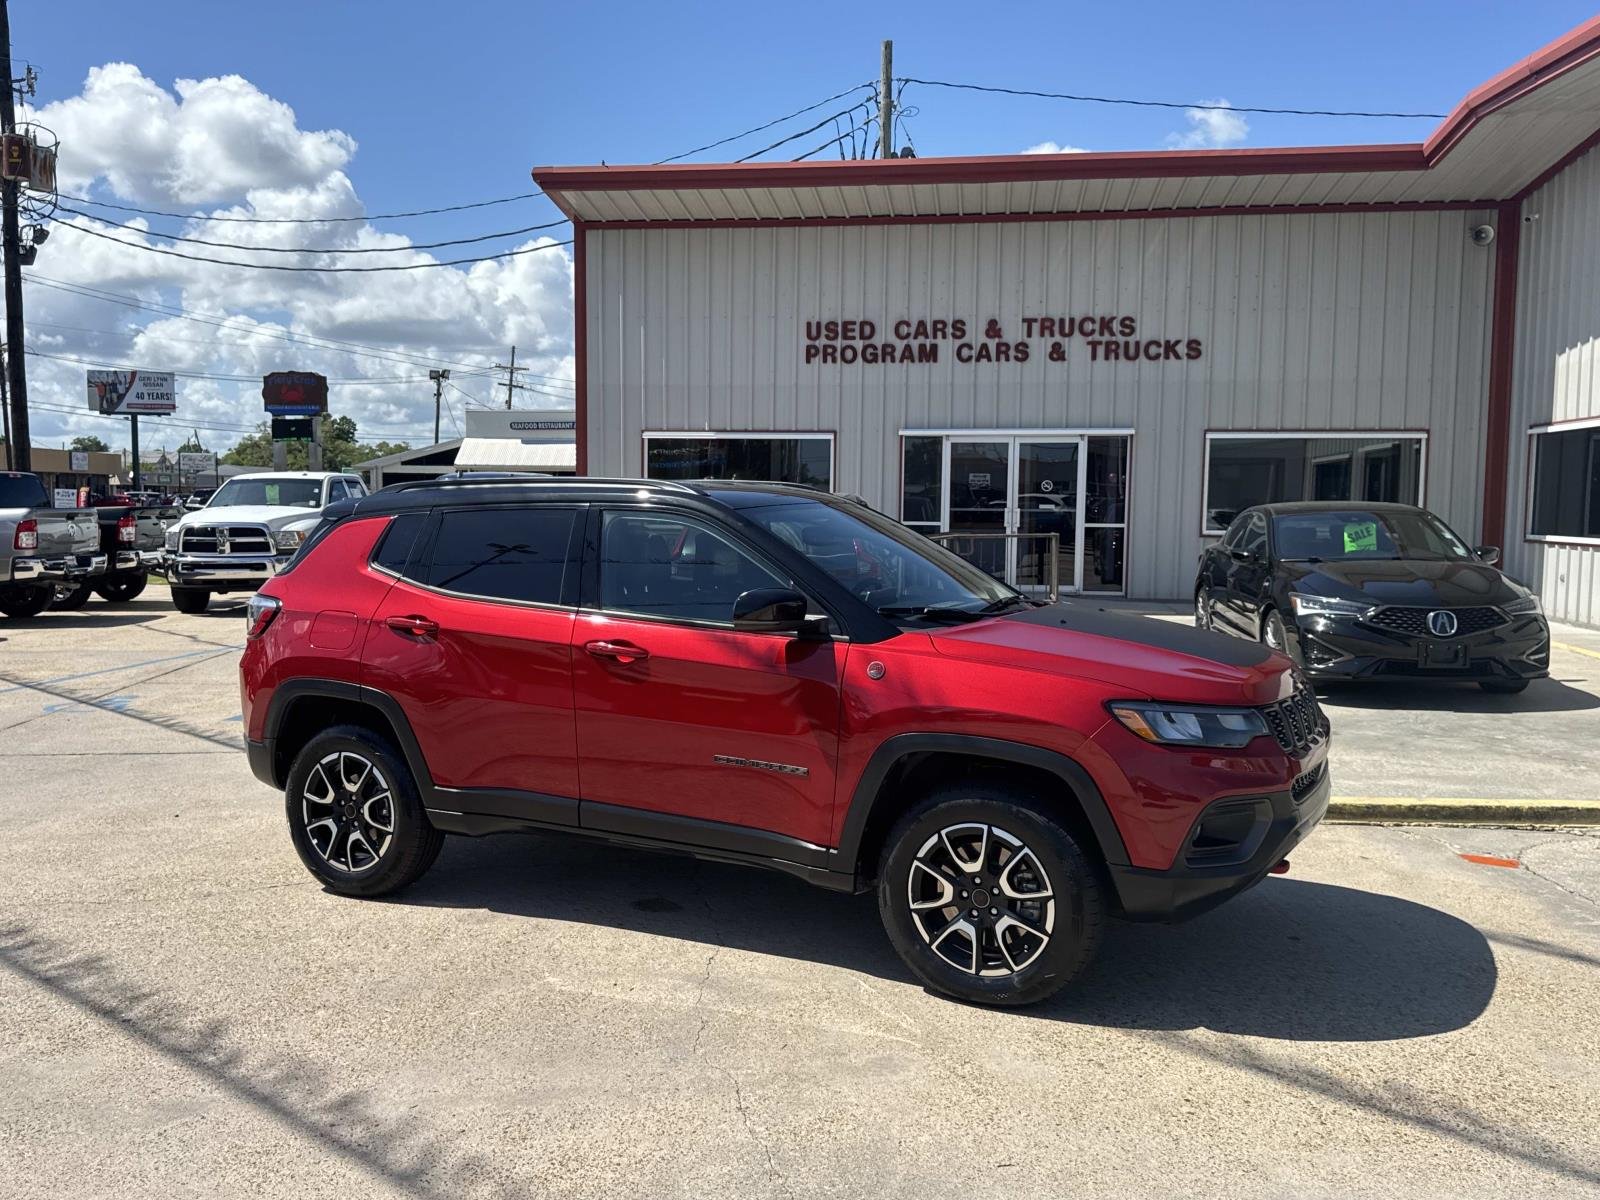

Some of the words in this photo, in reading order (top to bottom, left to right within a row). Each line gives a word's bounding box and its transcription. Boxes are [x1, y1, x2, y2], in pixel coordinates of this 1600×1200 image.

[806, 320, 875, 341] USED
[894, 319, 967, 341] CARS
[984, 318, 1003, 340] &
[1021, 316, 1136, 338] TRUCKS
[805, 343, 938, 364] PROGRAM
[956, 342, 1030, 363] CARS
[1048, 341, 1067, 362] &
[1086, 339, 1202, 361] TRUCKS
[136, 392, 145, 400] 40
[147, 391, 172, 401] YEARS!
[1347, 526, 1373, 543] SALE
